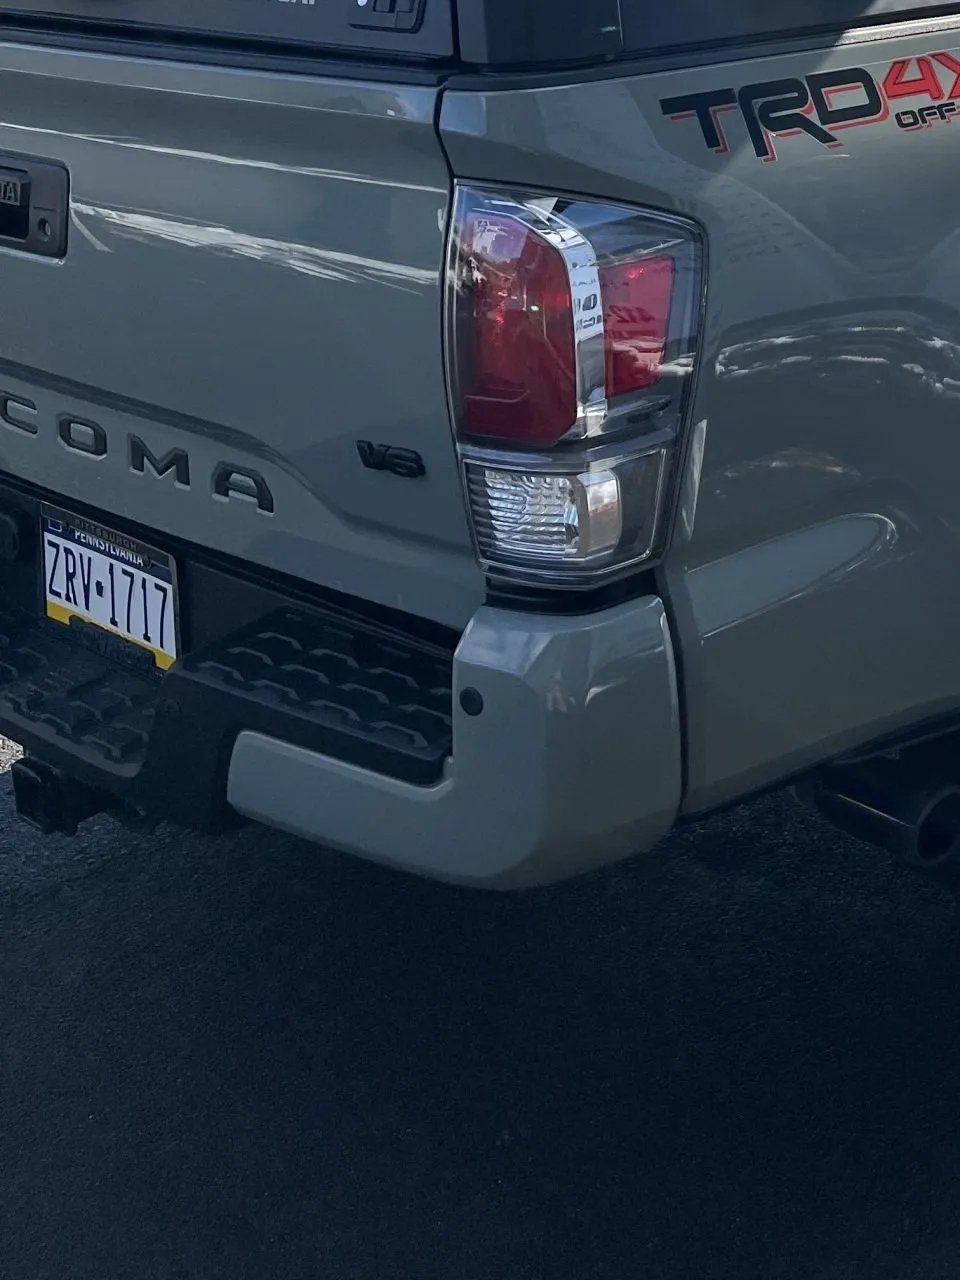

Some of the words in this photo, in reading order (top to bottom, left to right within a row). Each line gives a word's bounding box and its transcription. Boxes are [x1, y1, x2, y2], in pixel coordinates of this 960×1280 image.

[658, 66, 889, 162] TRD
[895, 101, 960, 132] OFF
[74, 528, 144, 567] PENNSYLVANIA
